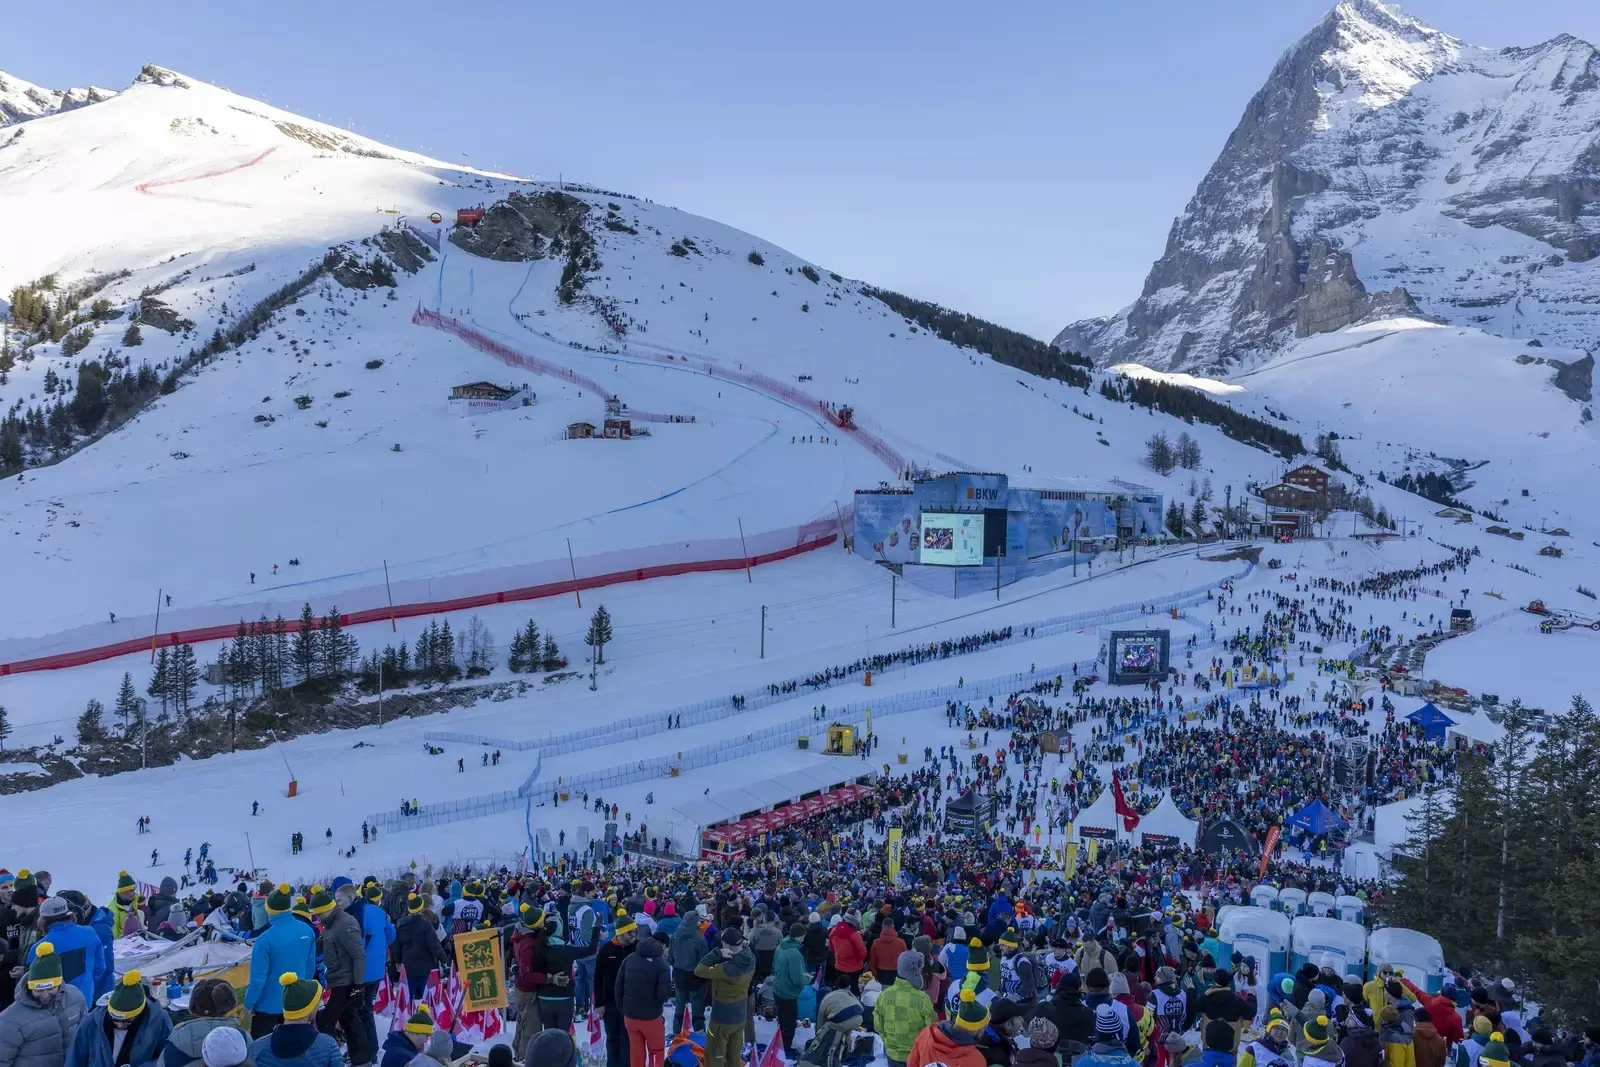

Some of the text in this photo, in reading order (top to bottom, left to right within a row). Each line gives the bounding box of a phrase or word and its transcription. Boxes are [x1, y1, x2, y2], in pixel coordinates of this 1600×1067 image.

[975, 488, 998, 500] BKW
[466, 921, 471, 930] 1
[467, 957, 492, 970] SAK
[1171, 1018, 1176, 1029] 1
